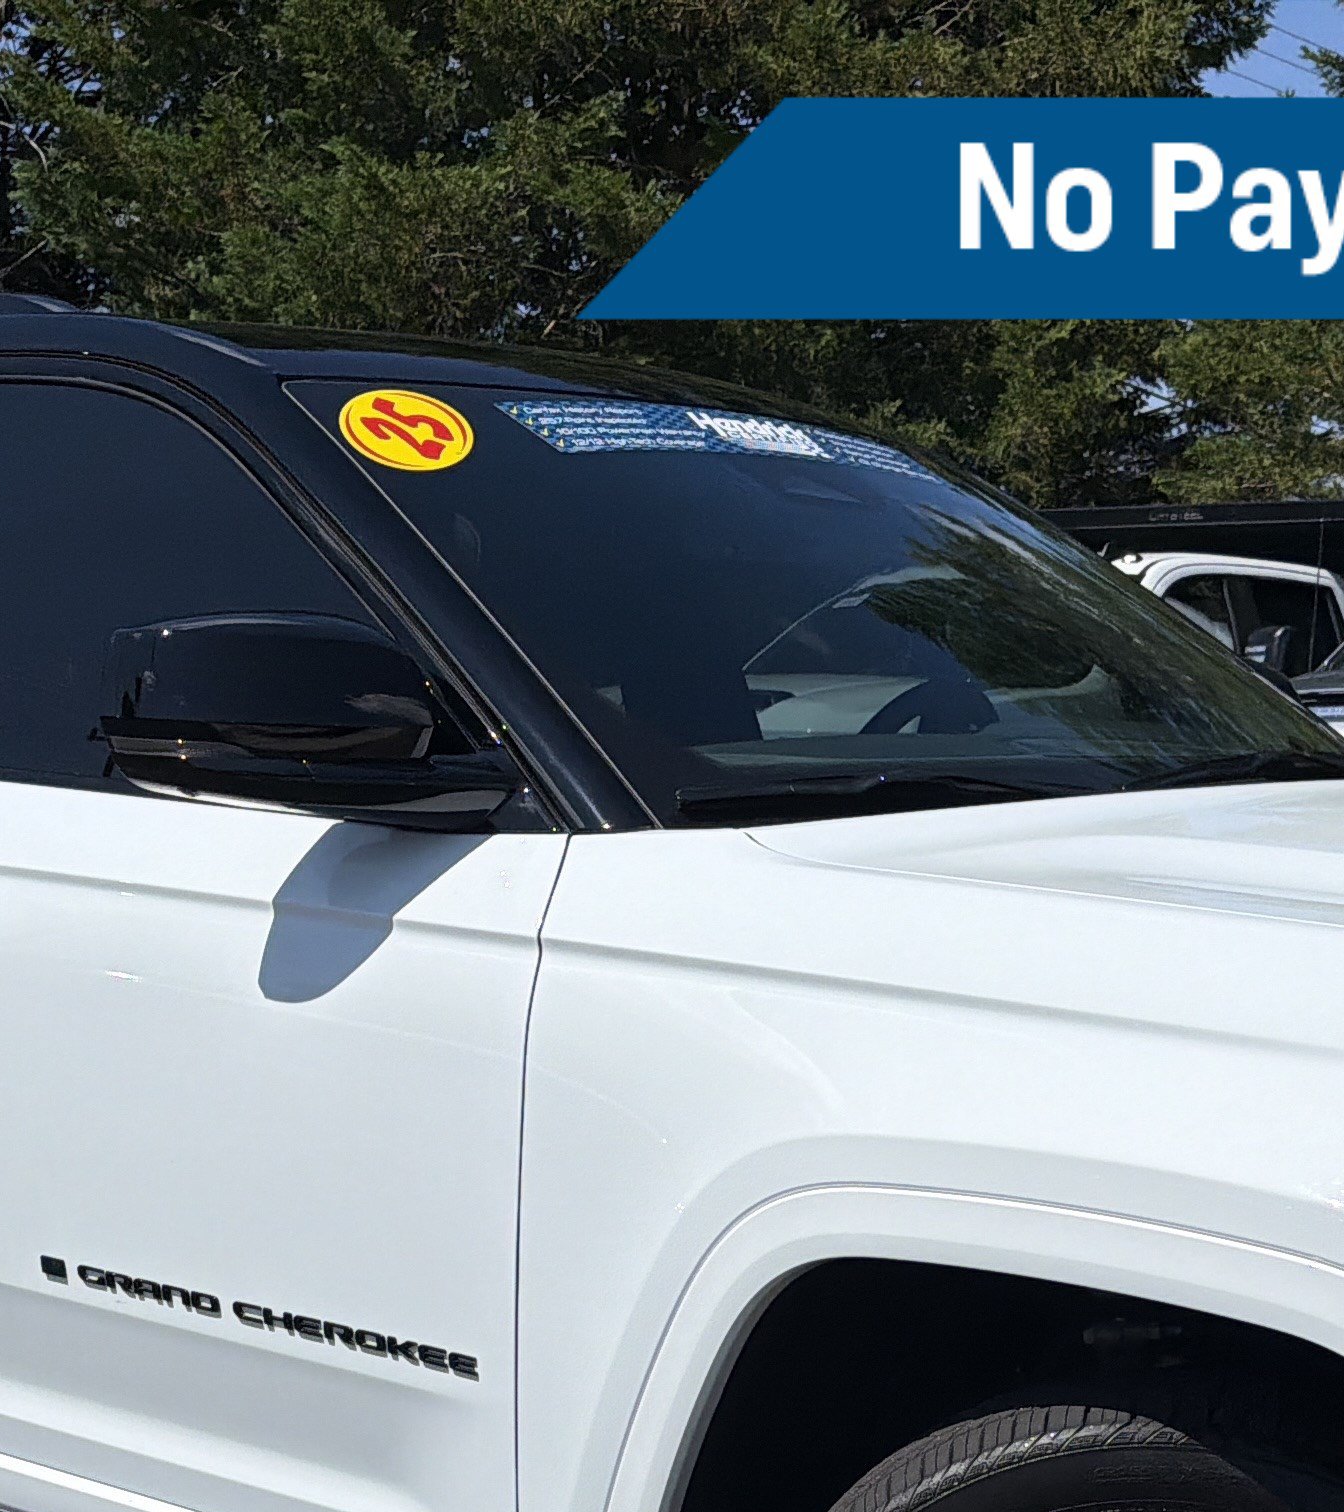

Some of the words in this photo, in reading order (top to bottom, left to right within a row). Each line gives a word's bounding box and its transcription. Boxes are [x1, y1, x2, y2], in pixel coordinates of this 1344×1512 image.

[359, 396, 455, 461] 25
[686, 411, 810, 448] Hendrick
[76, 1264, 221, 1318] GRAND
[232, 1300, 479, 1380] CHEROKEE
